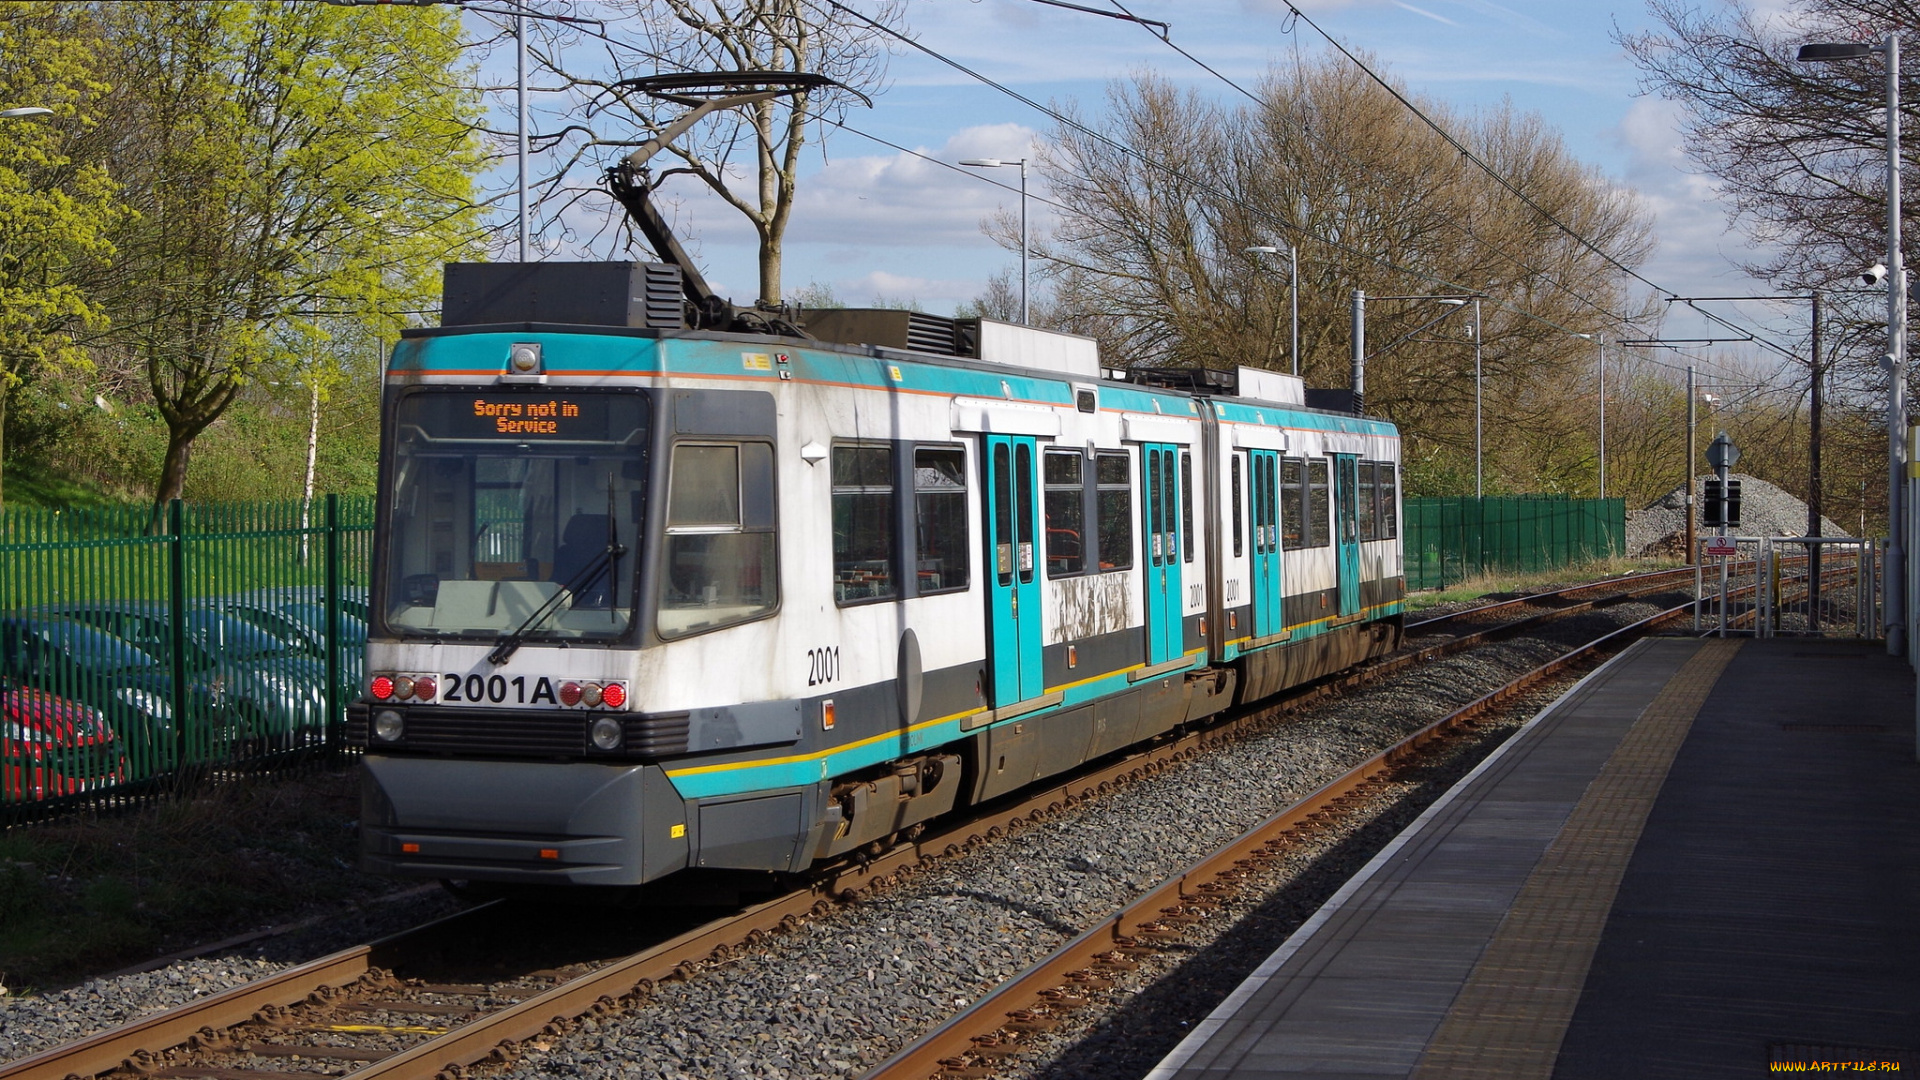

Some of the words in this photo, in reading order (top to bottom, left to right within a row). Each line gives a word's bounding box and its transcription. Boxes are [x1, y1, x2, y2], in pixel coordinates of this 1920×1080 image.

[474, 400, 522, 416] Sorry
[527, 401, 557, 416] not
[562, 401, 579, 416] in
[497, 417, 557, 433] Service
[808, 646, 841, 686] 2001
[444, 674, 557, 704] 2001A
